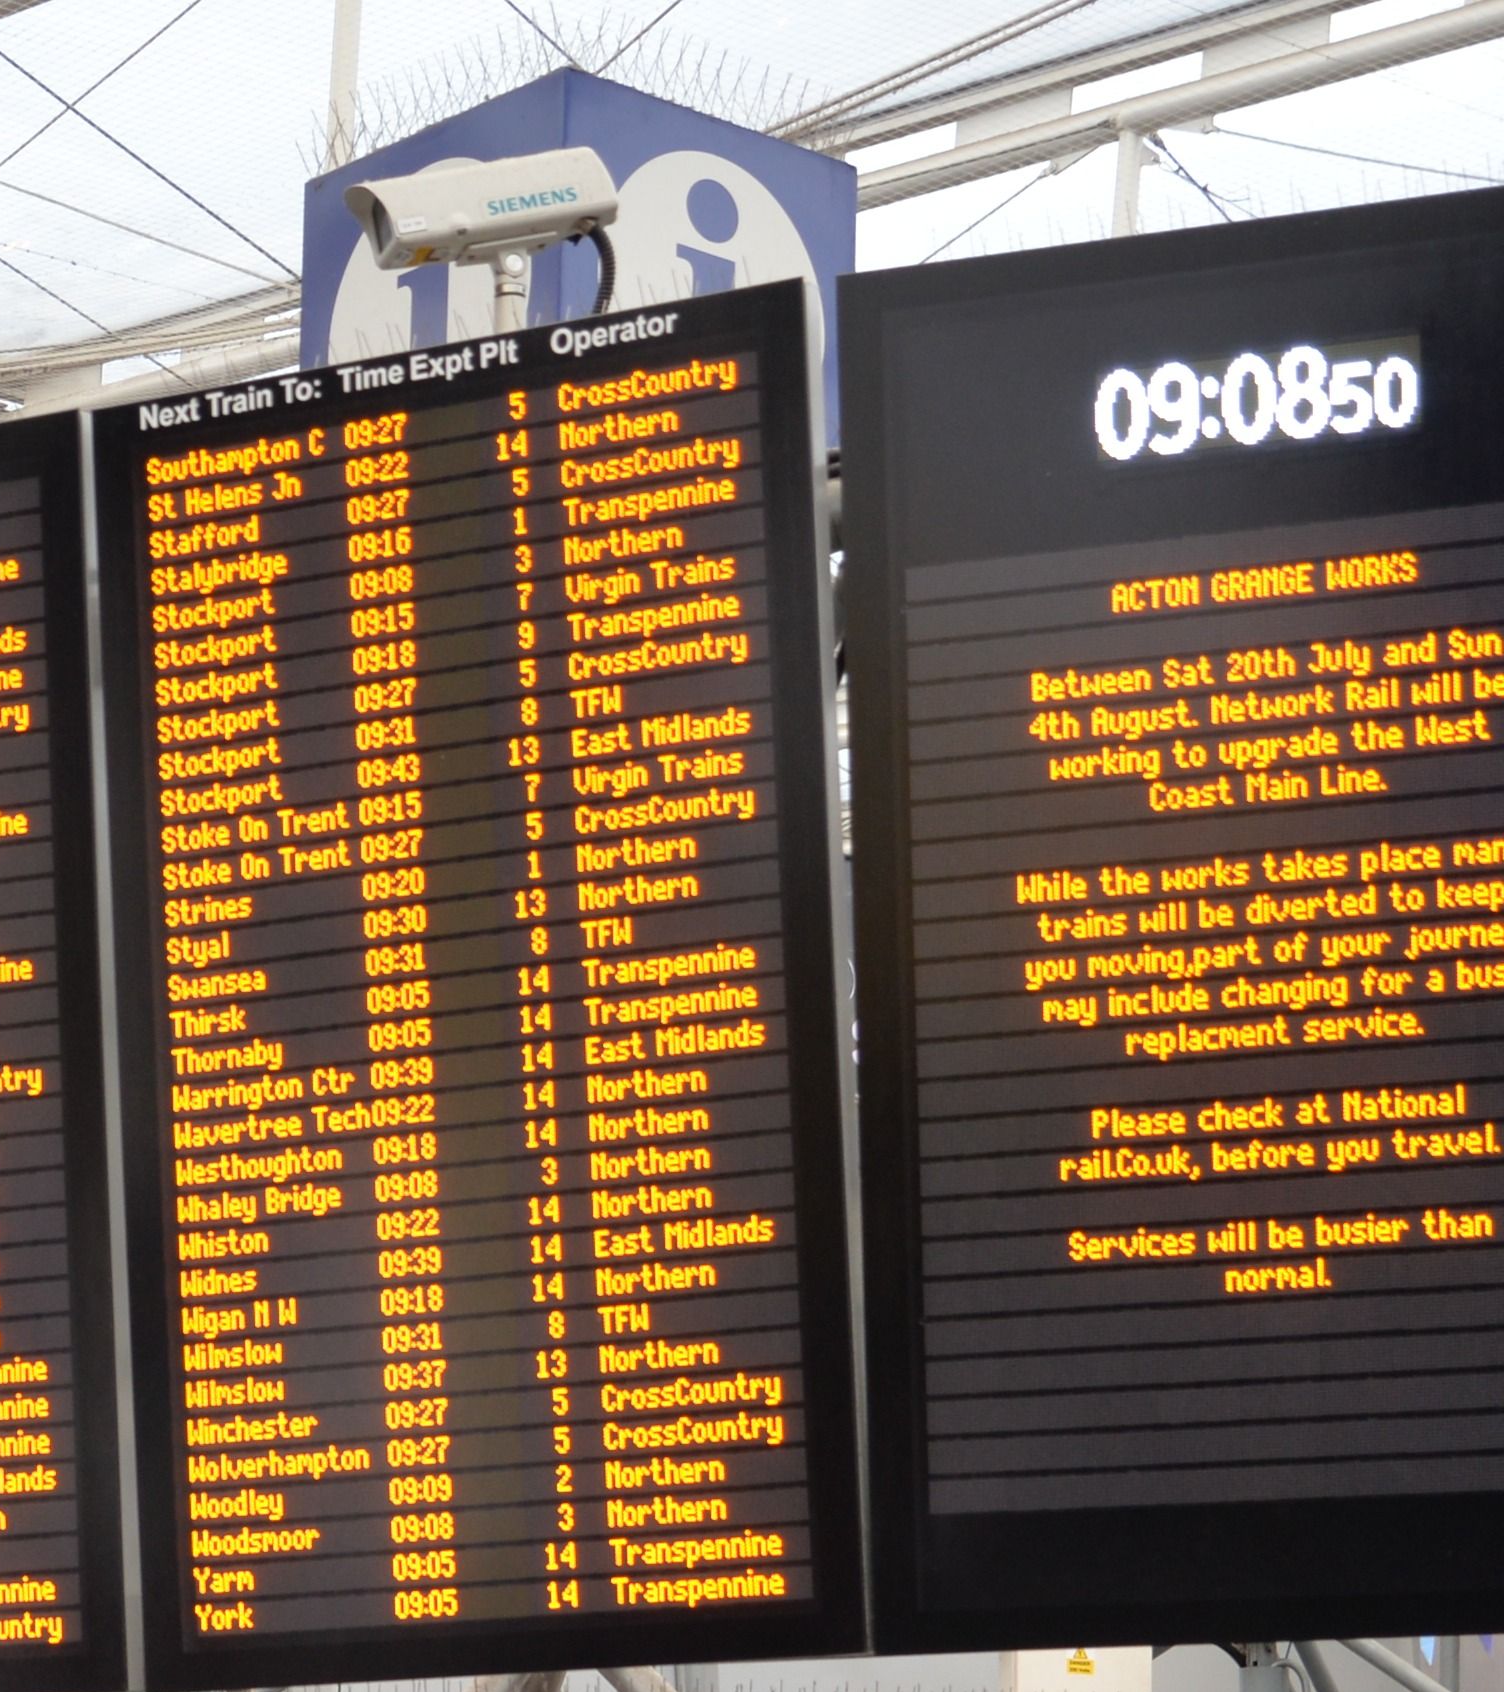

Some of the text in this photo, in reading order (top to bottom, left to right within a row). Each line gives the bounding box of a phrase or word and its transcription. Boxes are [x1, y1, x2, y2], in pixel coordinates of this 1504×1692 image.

[486, 185, 578, 217] SIEMENS
[139, 310, 679, 431] Next Train To: Time Expt Plt Operator
[1111, 550, 1420, 615] ACTON GRANGE WORKS
[1030, 627, 1504, 704] Between Sat 20th July and Sun
[1028, 709, 1082, 743] 4th
[1090, 697, 1201, 742] August.
[1210, 683, 1336, 726] Network
[1344, 676, 1402, 713] Rail
[1410, 670, 1464, 707] will
[1048, 709, 1492, 782] working to upgrade the West
[1148, 763, 1389, 813] Coast Main Line.
[1016, 869, 1090, 906] While
[1098, 865, 1153, 898] the
[1160, 856, 1252, 893] works
[1261, 849, 1350, 884] takes
[1359, 841, 1444, 883] place
[193, 1566, 787, 1633] York 09:05 14 Transpennine
